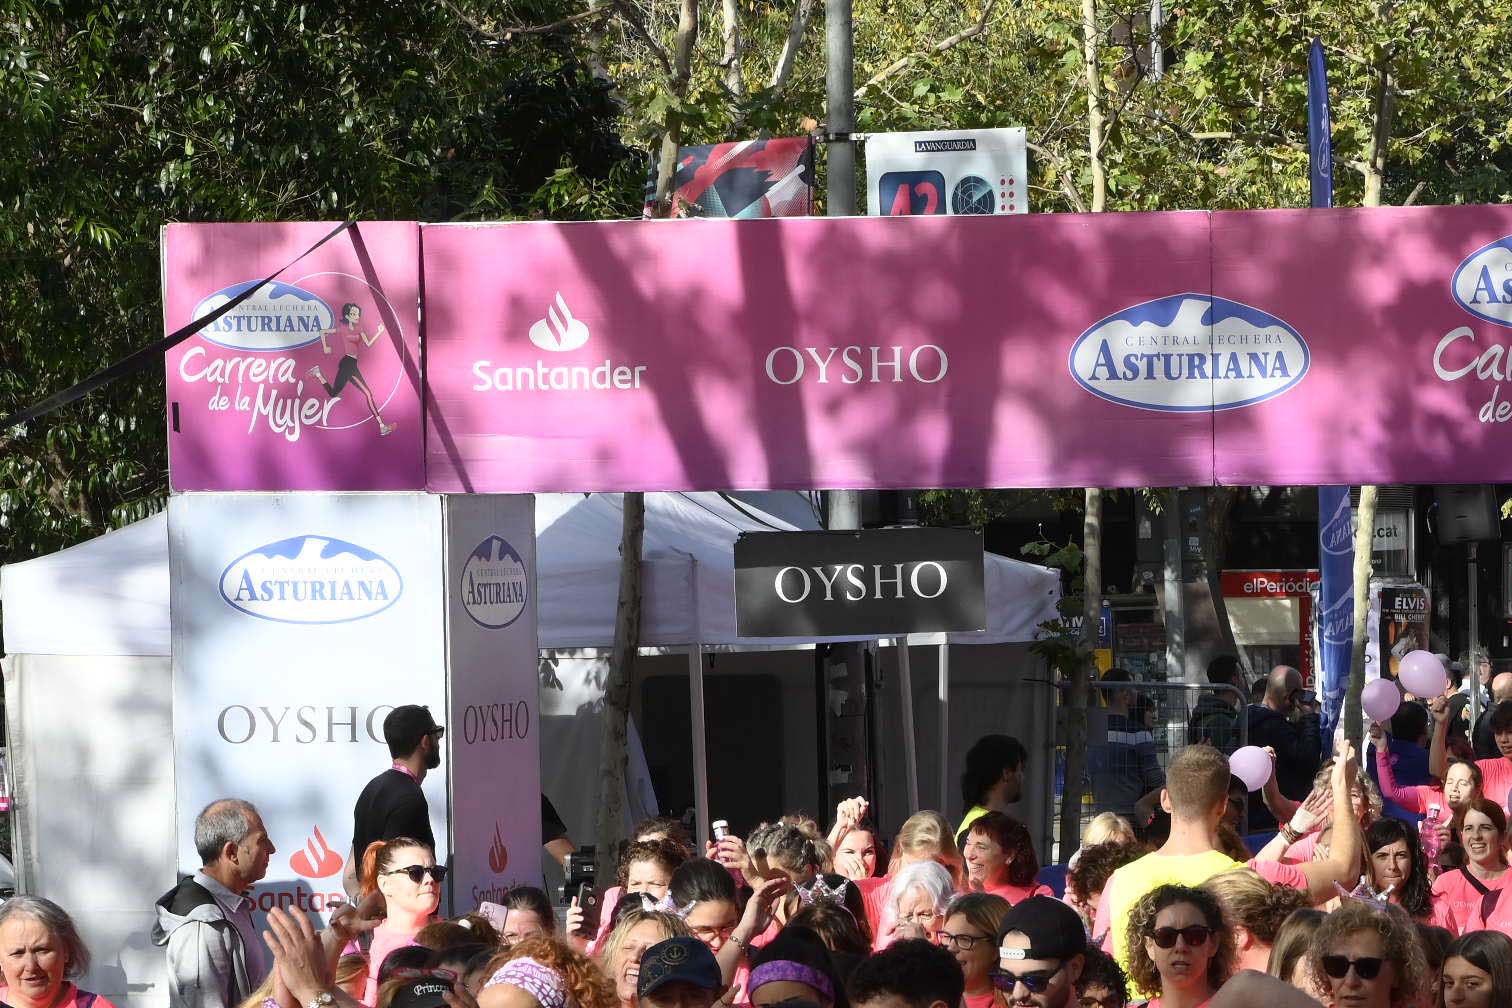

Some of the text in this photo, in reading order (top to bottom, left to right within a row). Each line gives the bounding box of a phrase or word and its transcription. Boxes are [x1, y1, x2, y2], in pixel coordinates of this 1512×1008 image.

[1124, 331, 1284, 348] CENTRAL LECHERA
[179, 346, 296, 384] Carrera
[472, 359, 648, 393] Santander
[764, 344, 949, 386] OYSHO
[1087, 338, 1291, 382] ASTURIANA
[208, 380, 342, 442] de la Mujer
[233, 567, 390, 602] ASTURIANA
[466, 571, 525, 607] ASTURIANA
[774, 561, 949, 604] OYSHO
[1394, 597, 1425, 610] ELVIS
[463, 700, 530, 746] OYSHO
